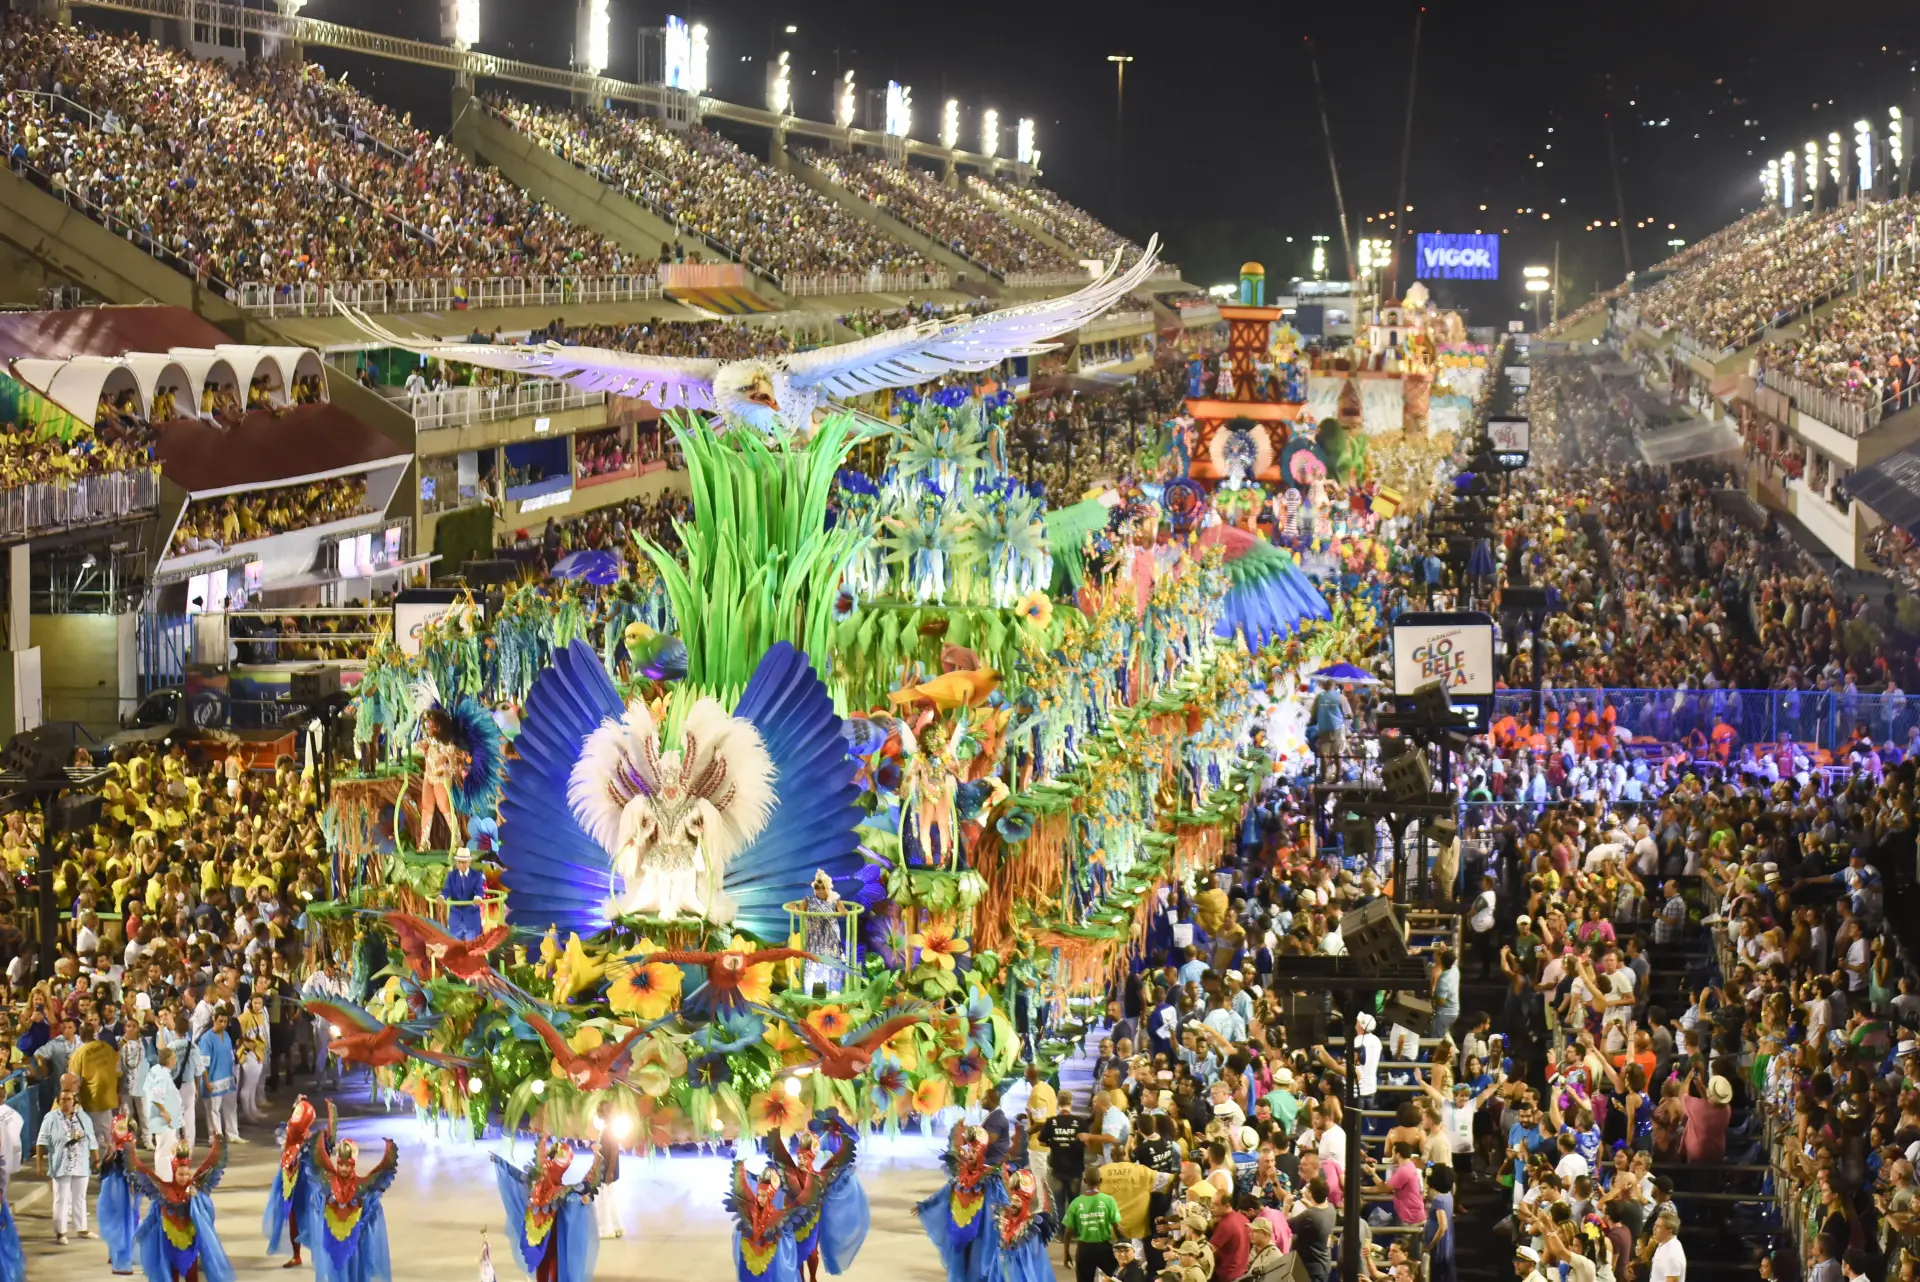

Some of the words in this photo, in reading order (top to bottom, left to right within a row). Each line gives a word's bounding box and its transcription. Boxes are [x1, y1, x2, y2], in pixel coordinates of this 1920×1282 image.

[1424, 247, 1491, 268] VIGOR
[1412, 639, 1453, 663] GLO
[1422, 650, 1465, 678] BELE
[1152, 1150, 1172, 1162] STAFF
[1107, 1168, 1132, 1176] STAFF
